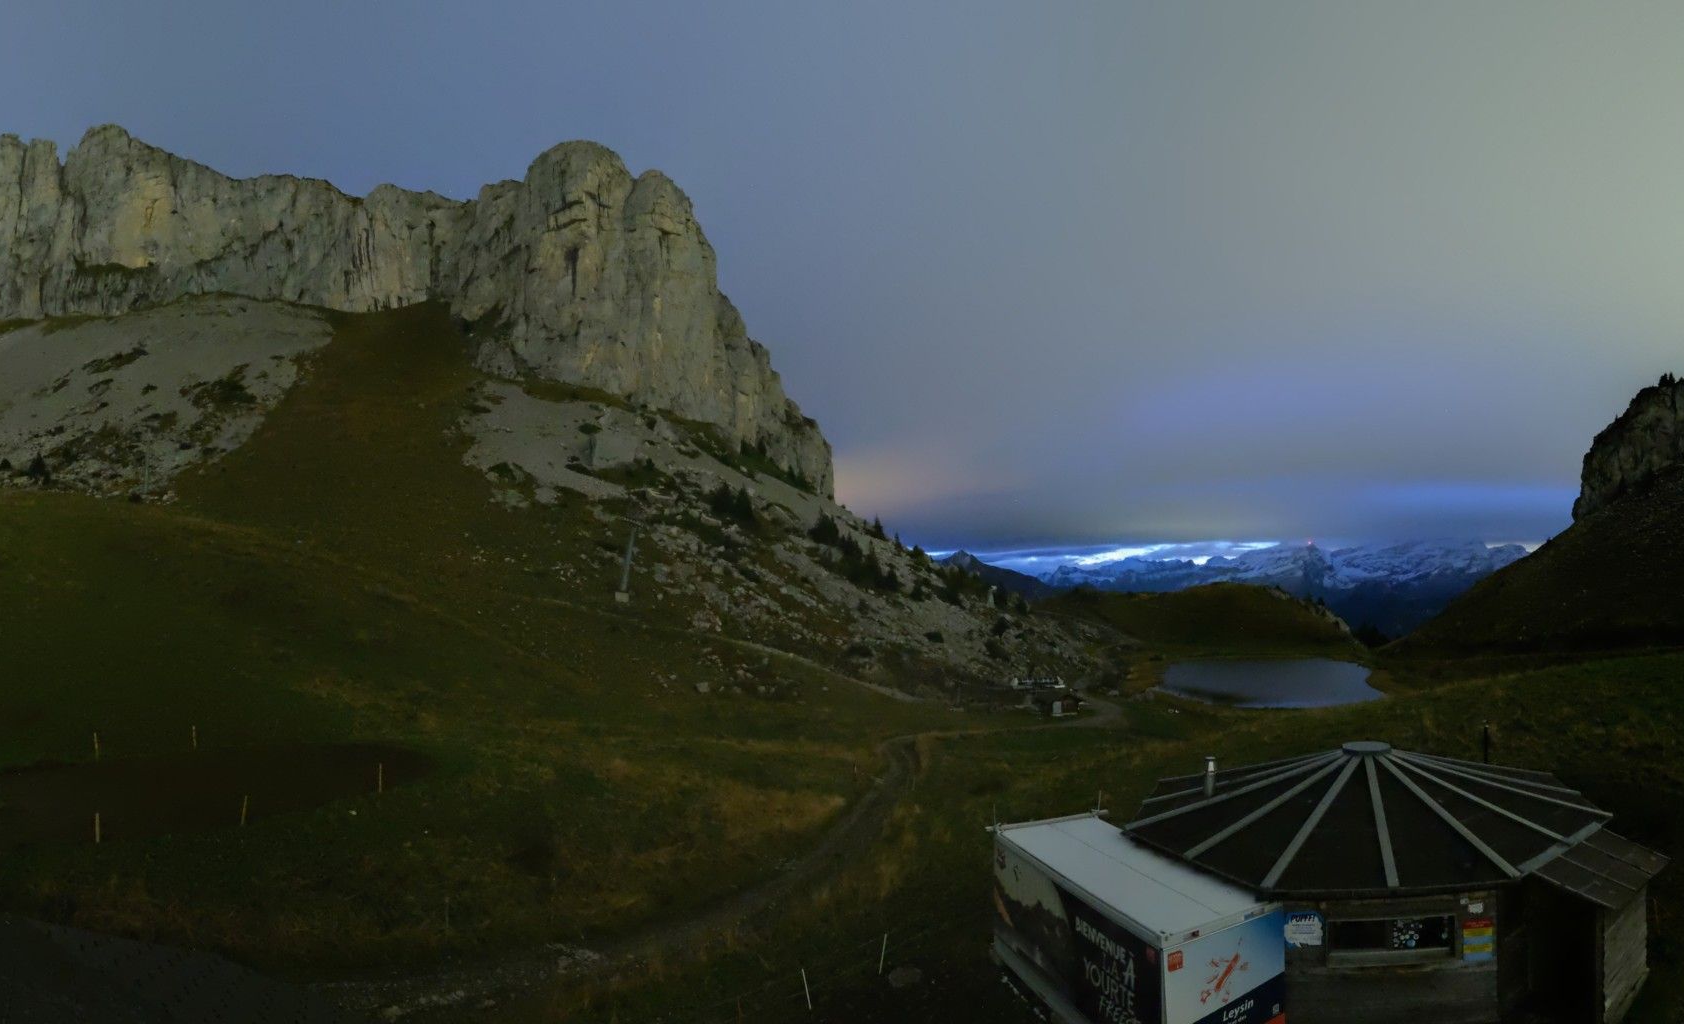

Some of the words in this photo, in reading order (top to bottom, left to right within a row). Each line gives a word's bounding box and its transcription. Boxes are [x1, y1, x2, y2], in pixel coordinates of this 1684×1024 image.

[1075, 915, 1127, 965] BIENVENUE
[1083, 956, 1136, 1010] YOURTE
[1222, 999, 1255, 1022] Leysin
